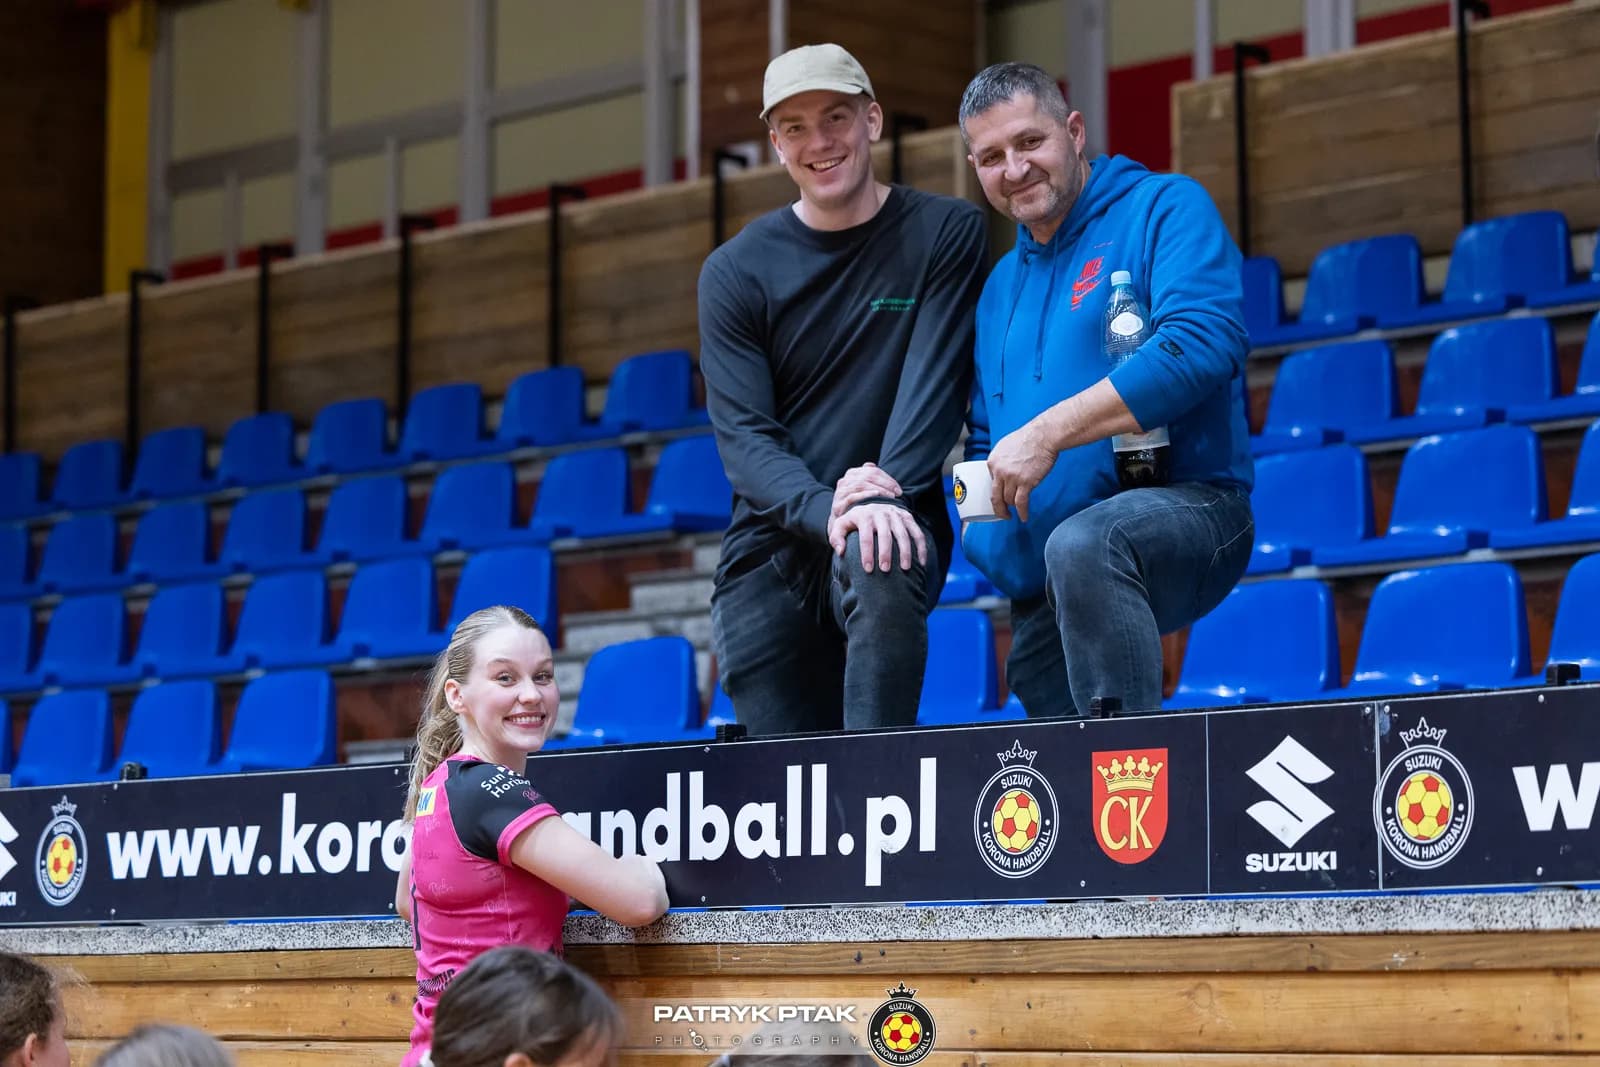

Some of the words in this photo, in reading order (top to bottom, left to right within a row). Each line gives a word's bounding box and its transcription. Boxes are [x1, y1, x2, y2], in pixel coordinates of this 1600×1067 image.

[1405, 754, 1442, 772] SUZUKI
[480, 773, 506, 791] Sun
[1000, 774, 1033, 789] SUZUKI
[1100, 795, 1153, 850] CK
[1386, 817, 1420, 860] KORONA
[1421, 814, 1466, 860] HANDBALL
[982, 831, 1011, 869] KORONA
[1012, 829, 1052, 869] HANDBALL
[1245, 850, 1337, 873] SUZUKI
